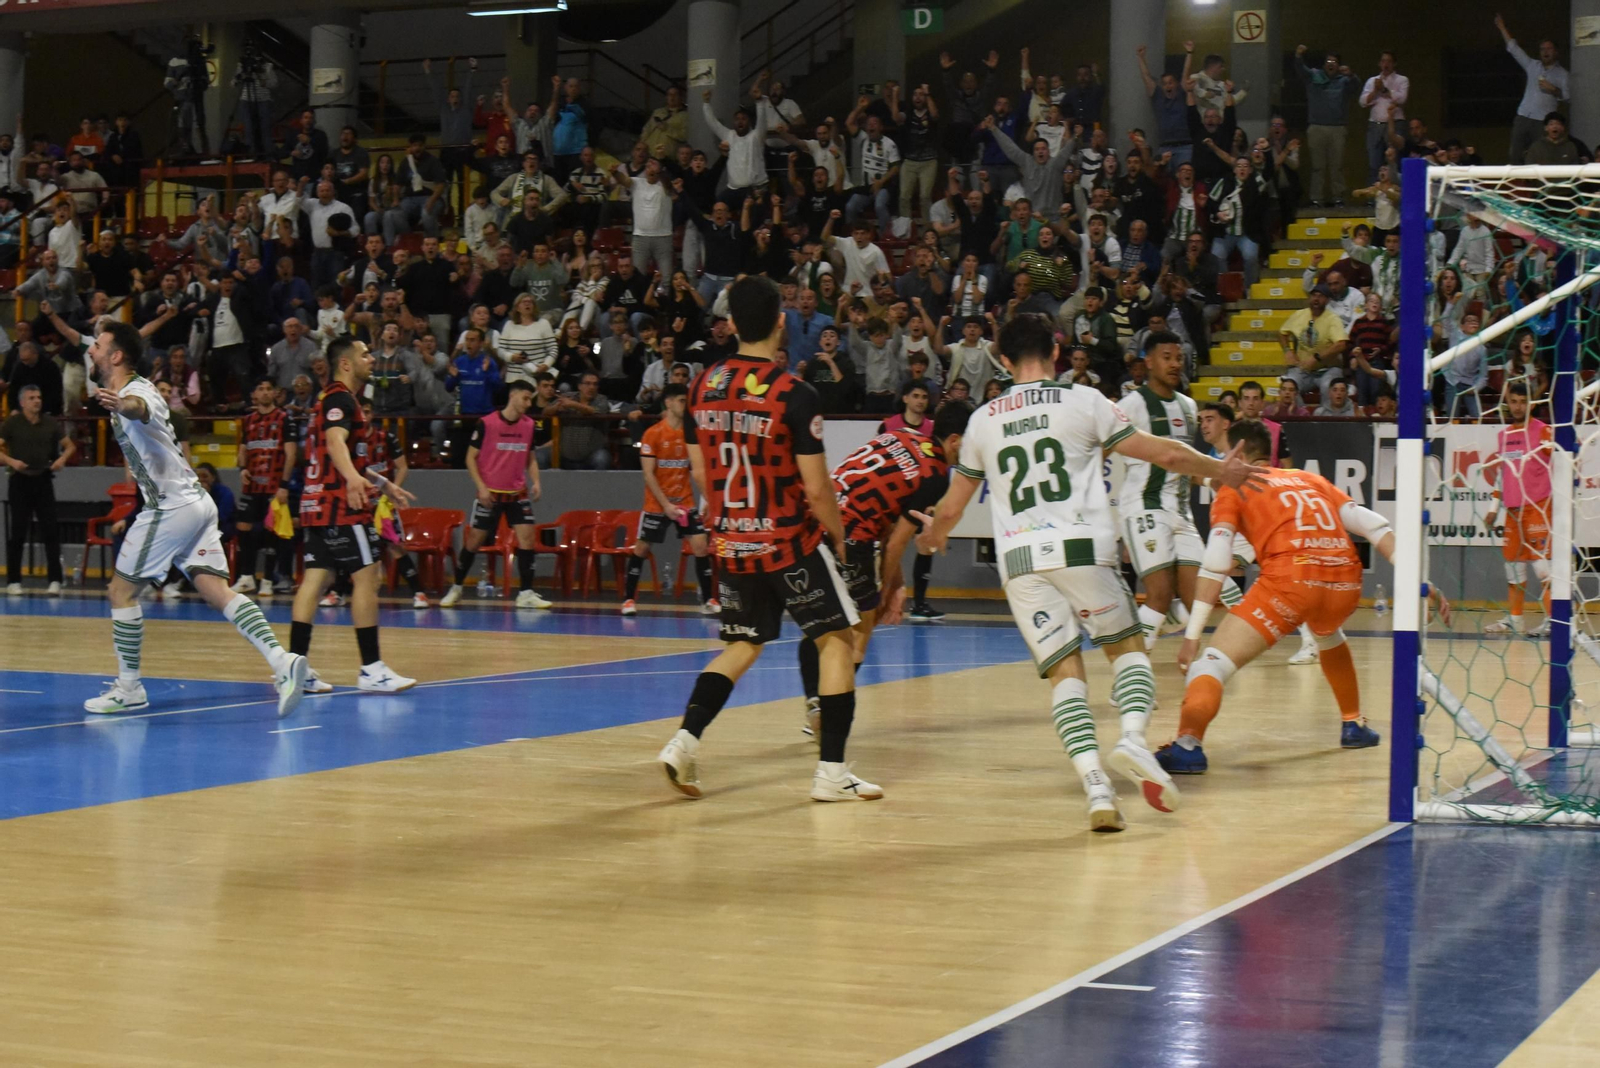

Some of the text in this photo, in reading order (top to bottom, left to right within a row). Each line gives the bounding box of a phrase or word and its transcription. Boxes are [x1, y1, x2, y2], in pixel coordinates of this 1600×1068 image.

[915, 8, 932, 29] D
[1002, 414, 1049, 438] MURILO
[719, 442, 756, 508] 21
[997, 437, 1070, 516] 23
[1279, 489, 1337, 531] 25
[1136, 514, 1155, 534] 25
[1303, 537, 1350, 549] AMBAR
